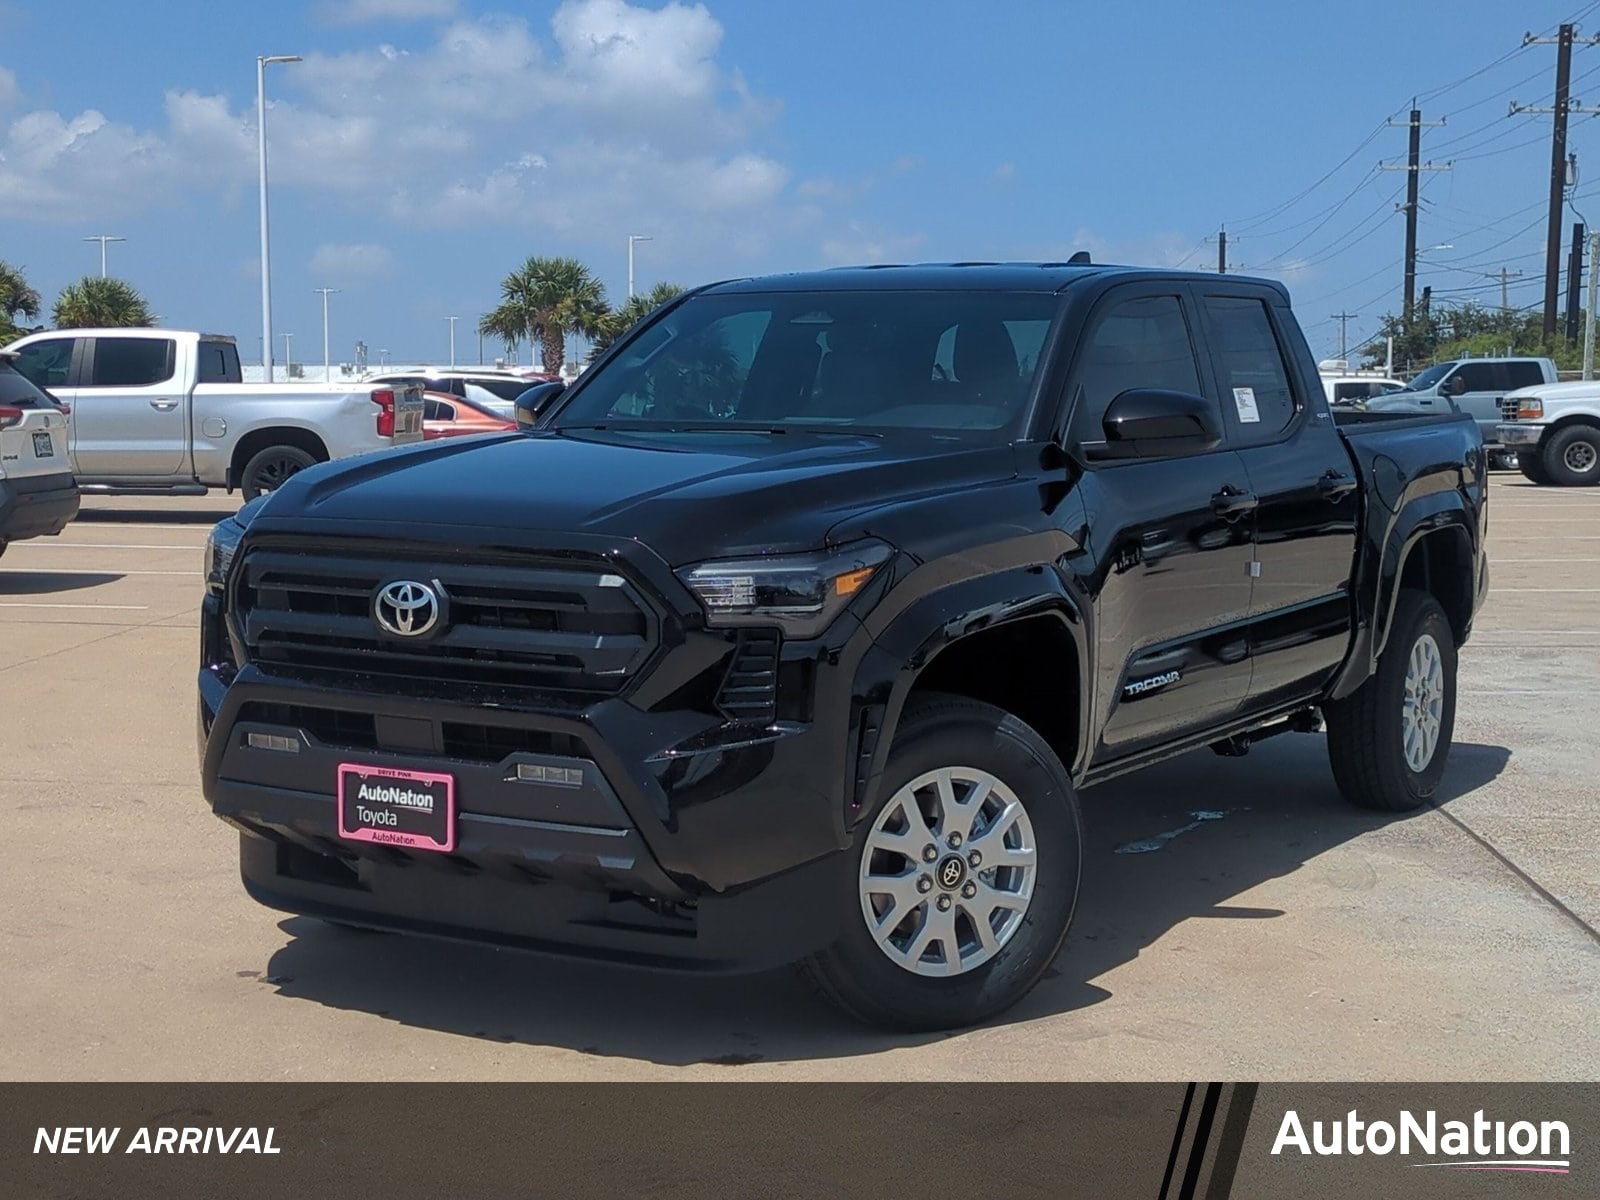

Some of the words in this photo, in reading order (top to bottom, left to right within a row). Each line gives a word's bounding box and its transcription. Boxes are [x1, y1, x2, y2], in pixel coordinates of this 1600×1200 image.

[1124, 671, 1180, 696] TACOMA
[358, 784, 433, 808] AutoNation
[356, 805, 398, 827] Toyota
[372, 832, 415, 845] AutoNation
